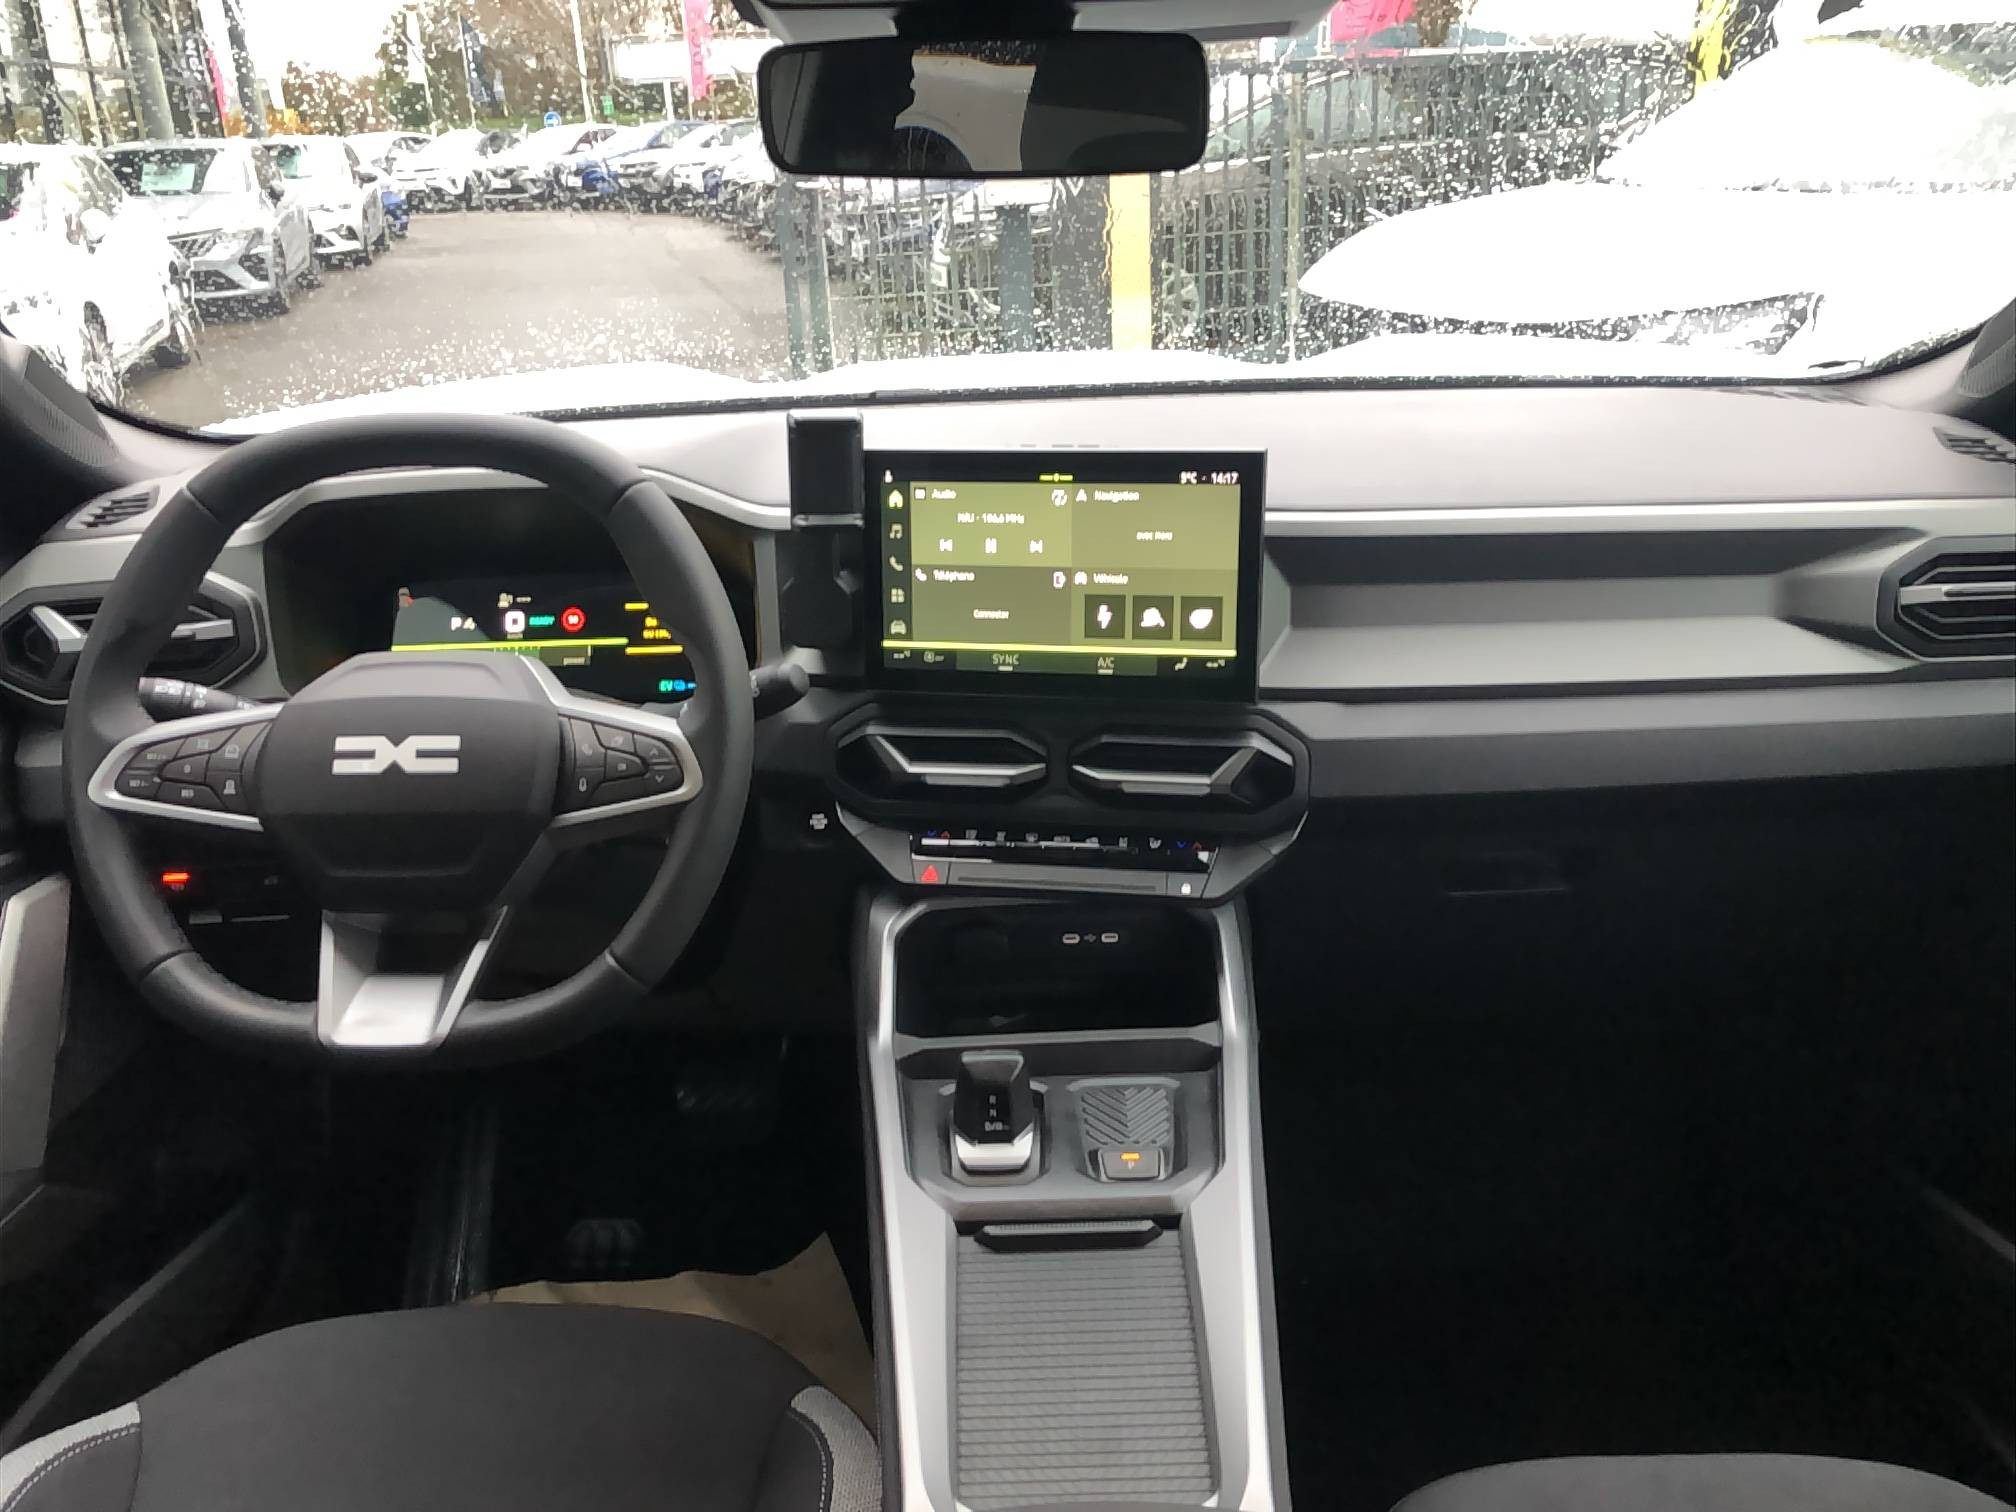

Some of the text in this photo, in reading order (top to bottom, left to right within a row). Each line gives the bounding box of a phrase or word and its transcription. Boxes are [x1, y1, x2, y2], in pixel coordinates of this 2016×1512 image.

[1211, 471, 1239, 484] 14:17
[931, 488, 957, 499] Audio
[1094, 490, 1140, 503] Navigation
[992, 653, 1020, 665] SYNC
[1097, 657, 1115, 668] A/C
